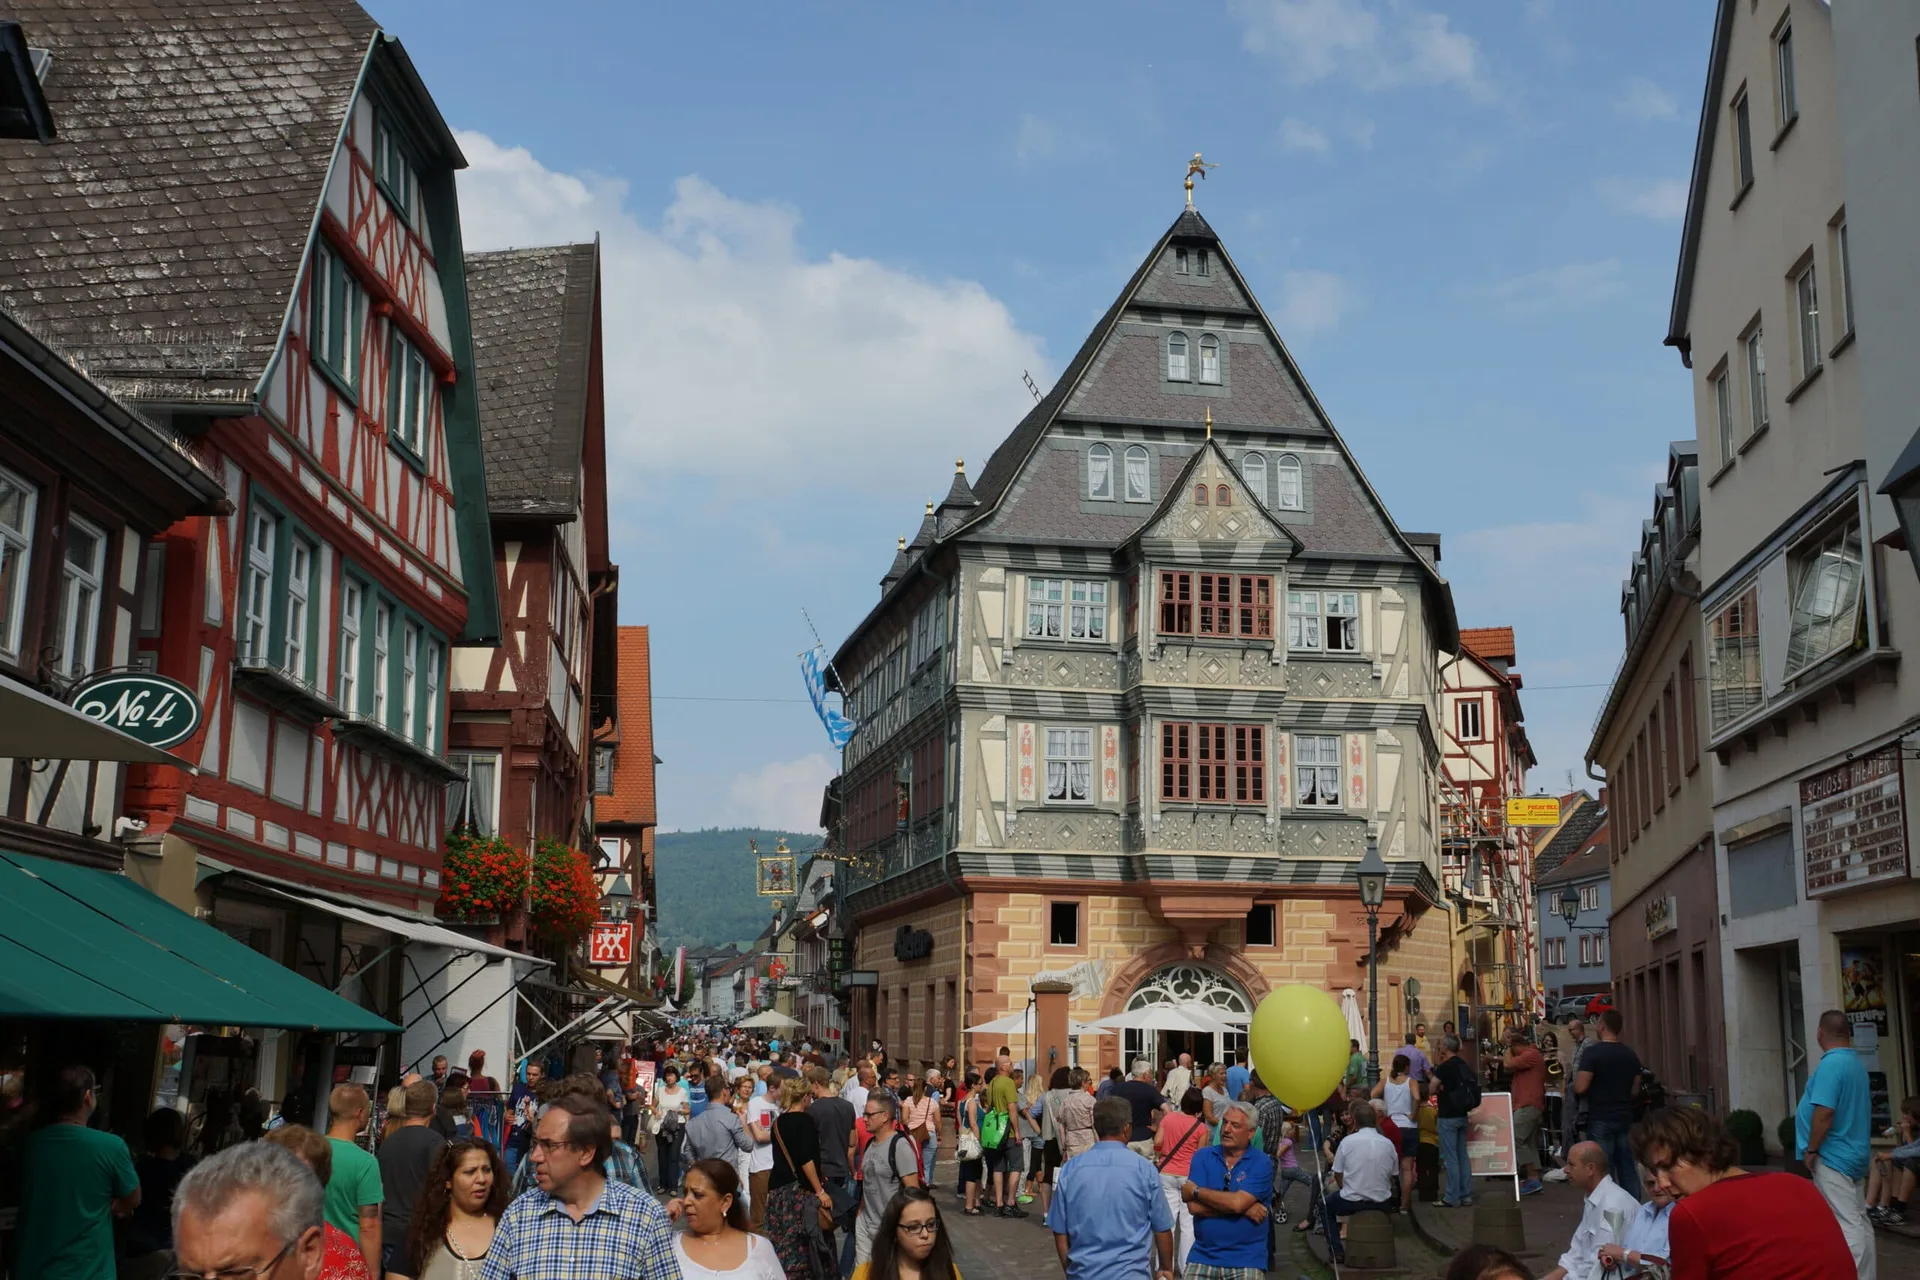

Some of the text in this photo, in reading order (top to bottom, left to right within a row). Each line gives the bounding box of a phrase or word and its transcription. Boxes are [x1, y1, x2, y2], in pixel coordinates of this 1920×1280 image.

[147, 693, 177, 728] 4
[1808, 772, 1843, 801] SCHLOSS
[1850, 754, 1890, 785] THEATER
[832, 940, 842, 990] HOTEL
